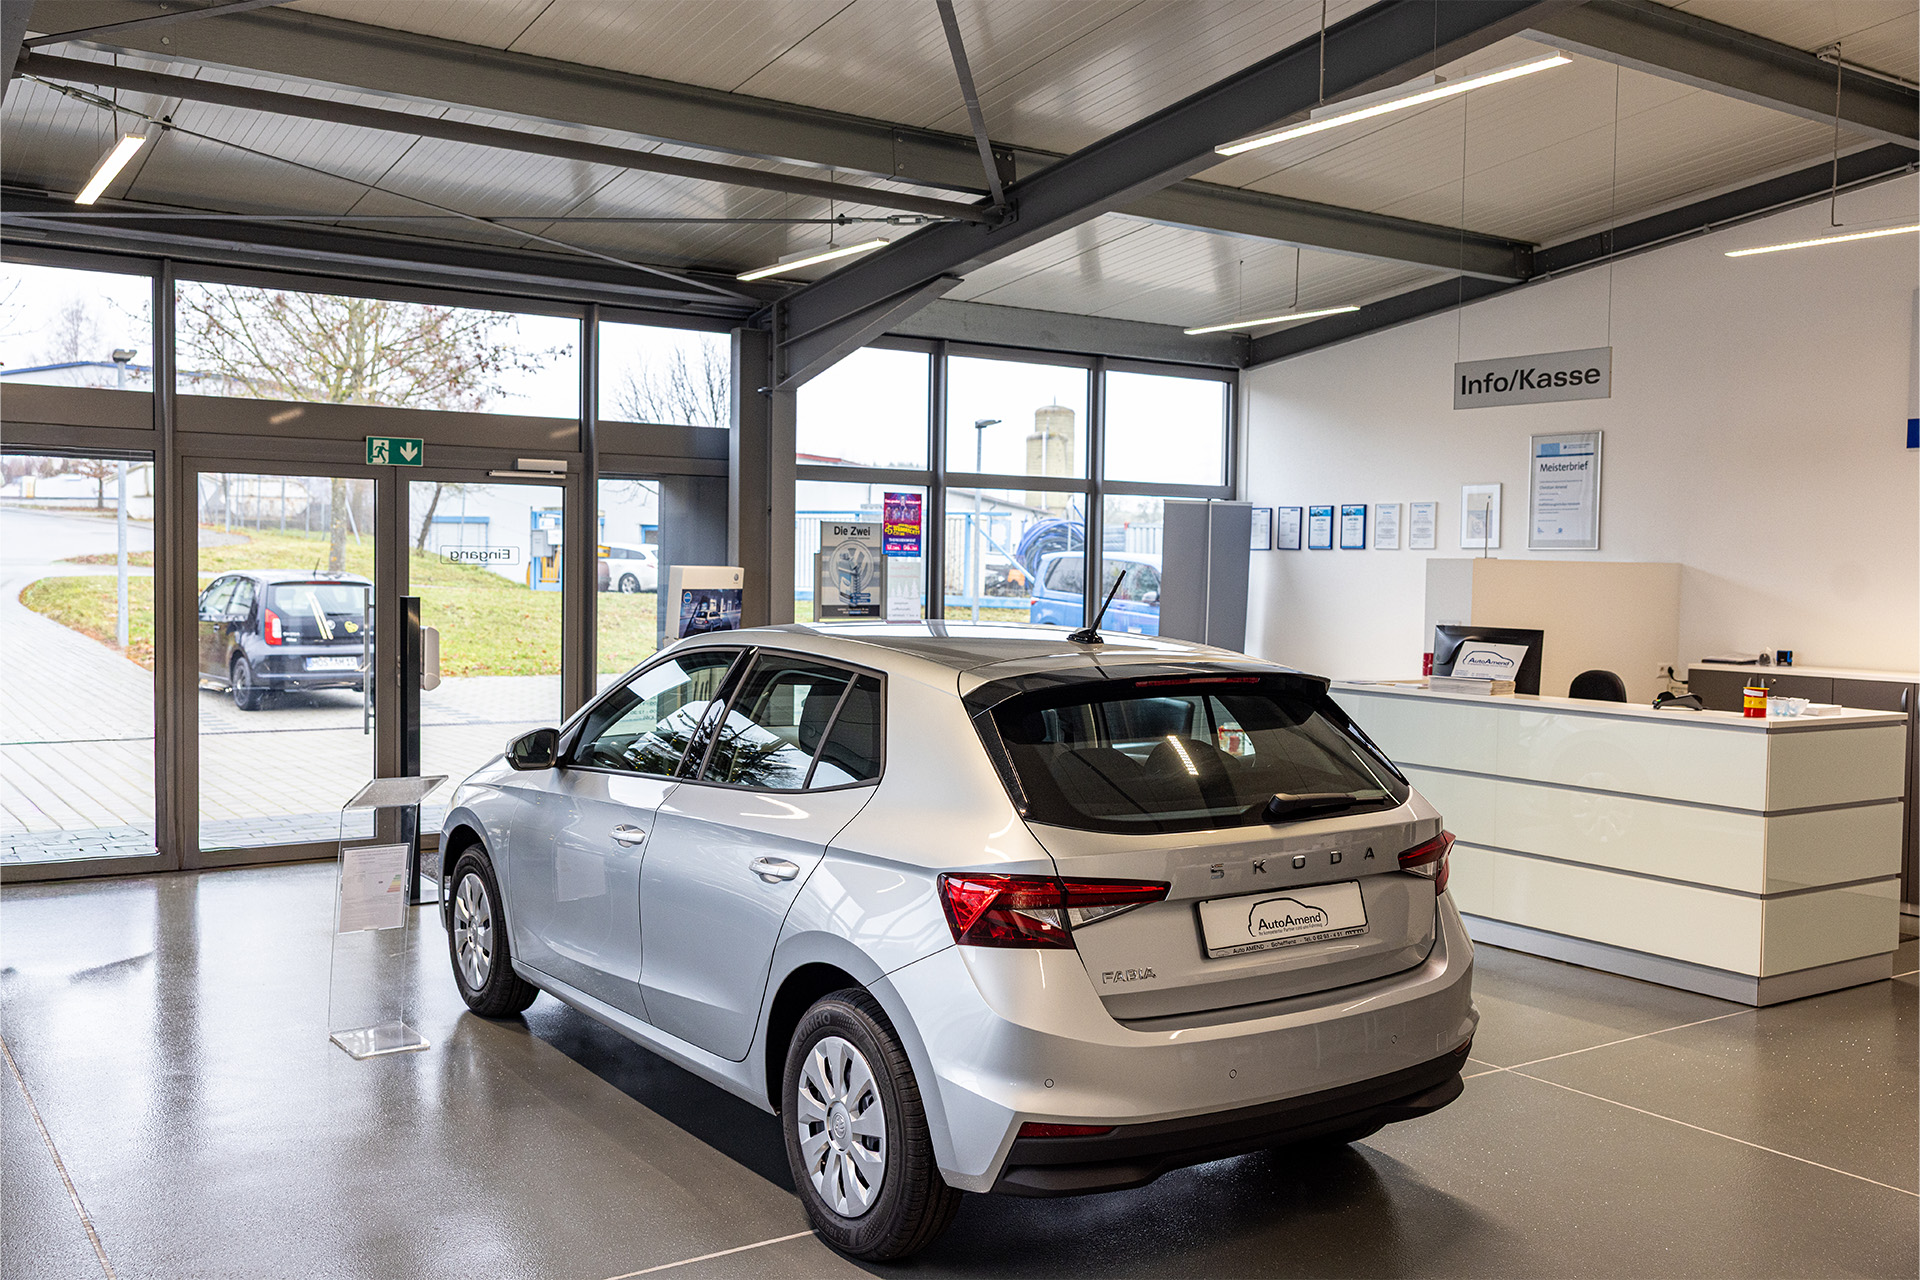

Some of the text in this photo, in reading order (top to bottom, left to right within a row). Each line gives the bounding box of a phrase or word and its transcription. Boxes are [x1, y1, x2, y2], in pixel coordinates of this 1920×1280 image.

[1461, 368, 1601, 395] Info/Kasse
[1540, 460, 1589, 472] Meisterbrief
[834, 526, 871, 536] Die Zwei
[1468, 657, 1510, 666] AutoAmend
[1210, 847, 1375, 879] SKODA
[1258, 912, 1322, 931] AutoAmend
[1245, 944, 1265, 953] AMEND
[1102, 966, 1156, 984] FABIA
